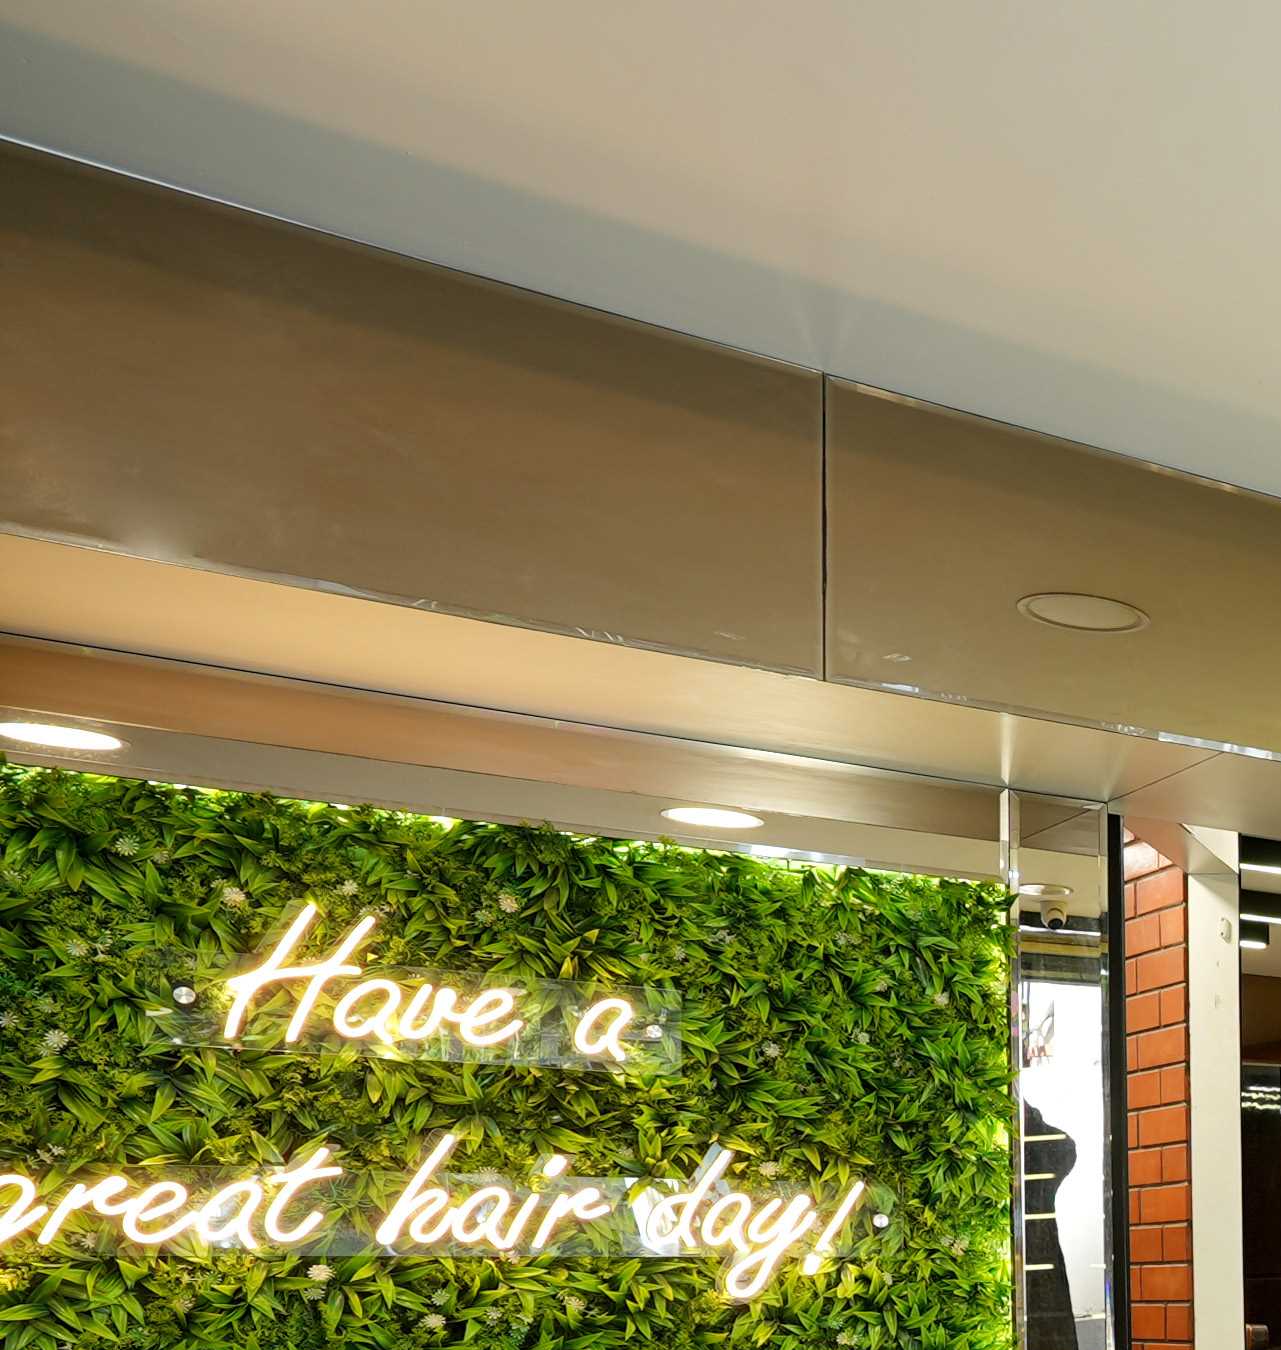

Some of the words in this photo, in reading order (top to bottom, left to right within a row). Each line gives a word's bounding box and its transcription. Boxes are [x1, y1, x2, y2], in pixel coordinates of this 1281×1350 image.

[223, 900, 523, 1042] Have
[573, 997, 630, 1063] a
[375, 1133, 609, 1253] hair
[648, 1149, 864, 1301] day!
